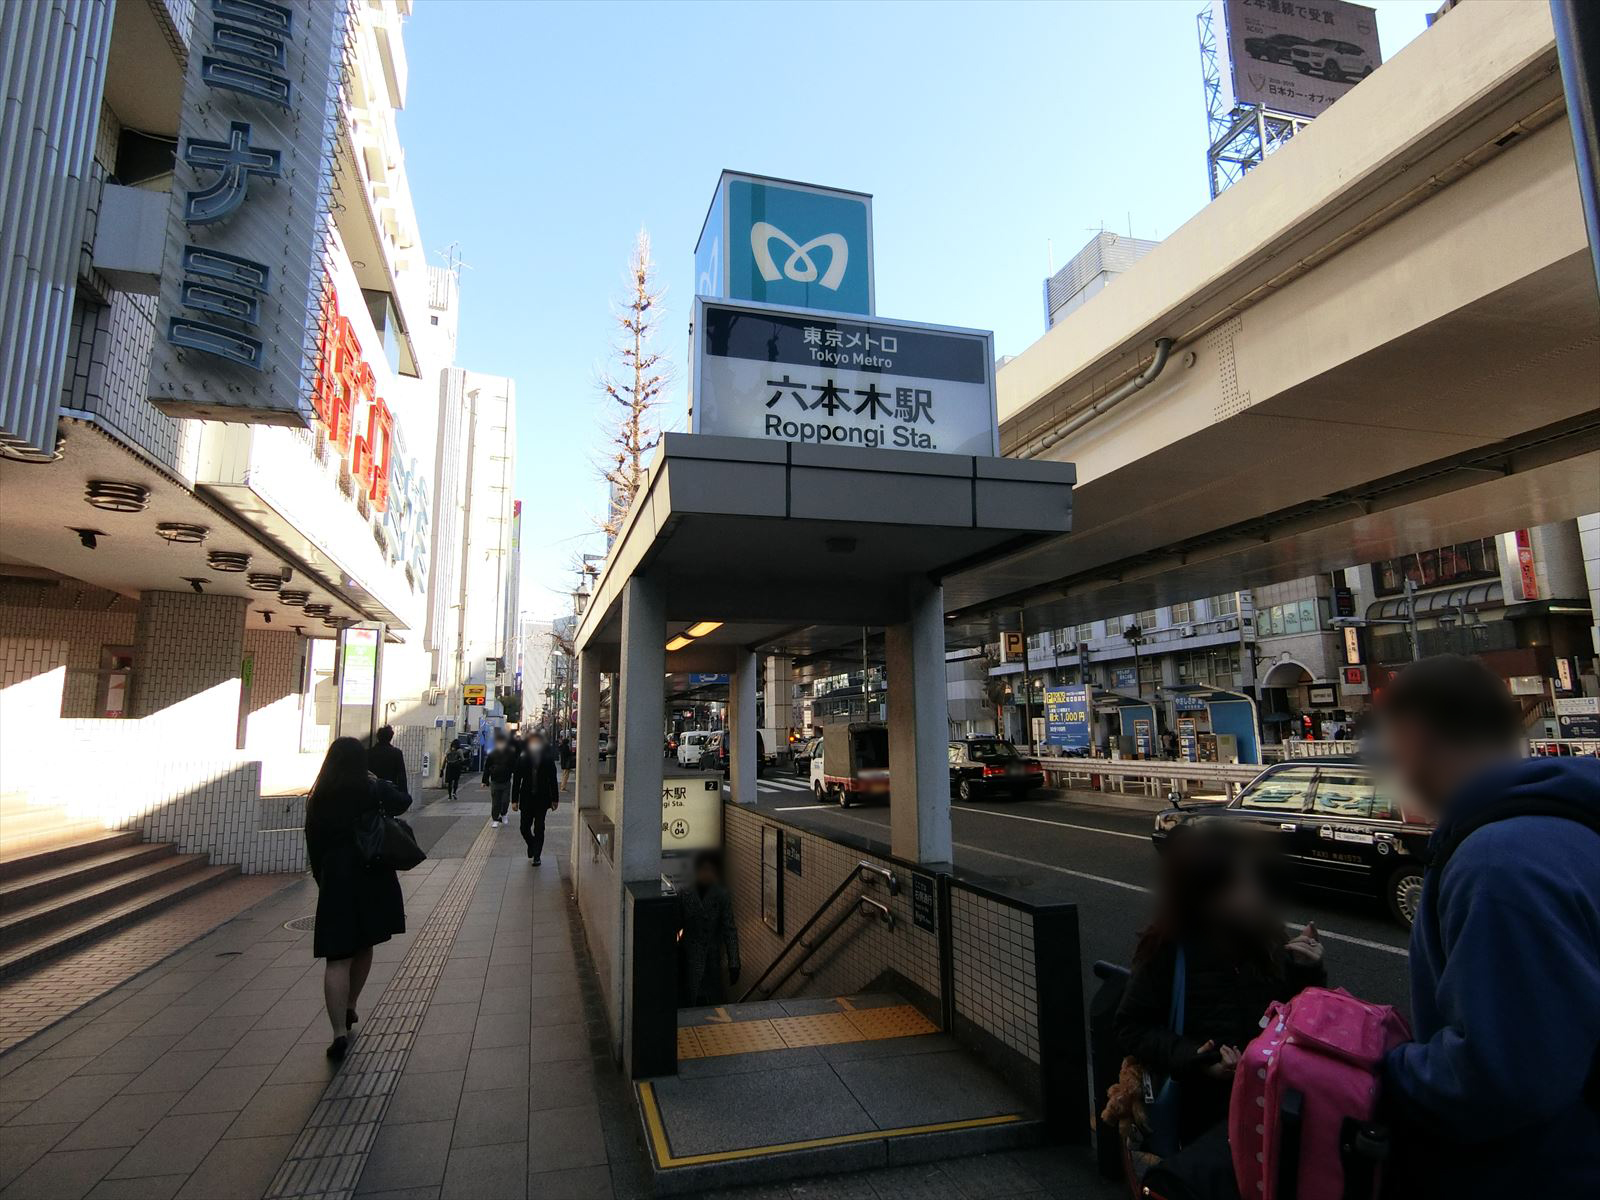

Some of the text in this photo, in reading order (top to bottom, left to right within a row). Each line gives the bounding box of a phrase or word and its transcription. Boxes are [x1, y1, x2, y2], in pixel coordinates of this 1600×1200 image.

[803, 326, 898, 354] 東京メトロ
[809, 346, 893, 369] Tokyo Metro
[764, 374, 936, 425] 六本木駅
[765, 414, 938, 451] Roppongi Sta.
[1008, 634, 1020, 652] P
[662, 786, 687, 800] 木駅
[674, 828, 685, 836] 04
